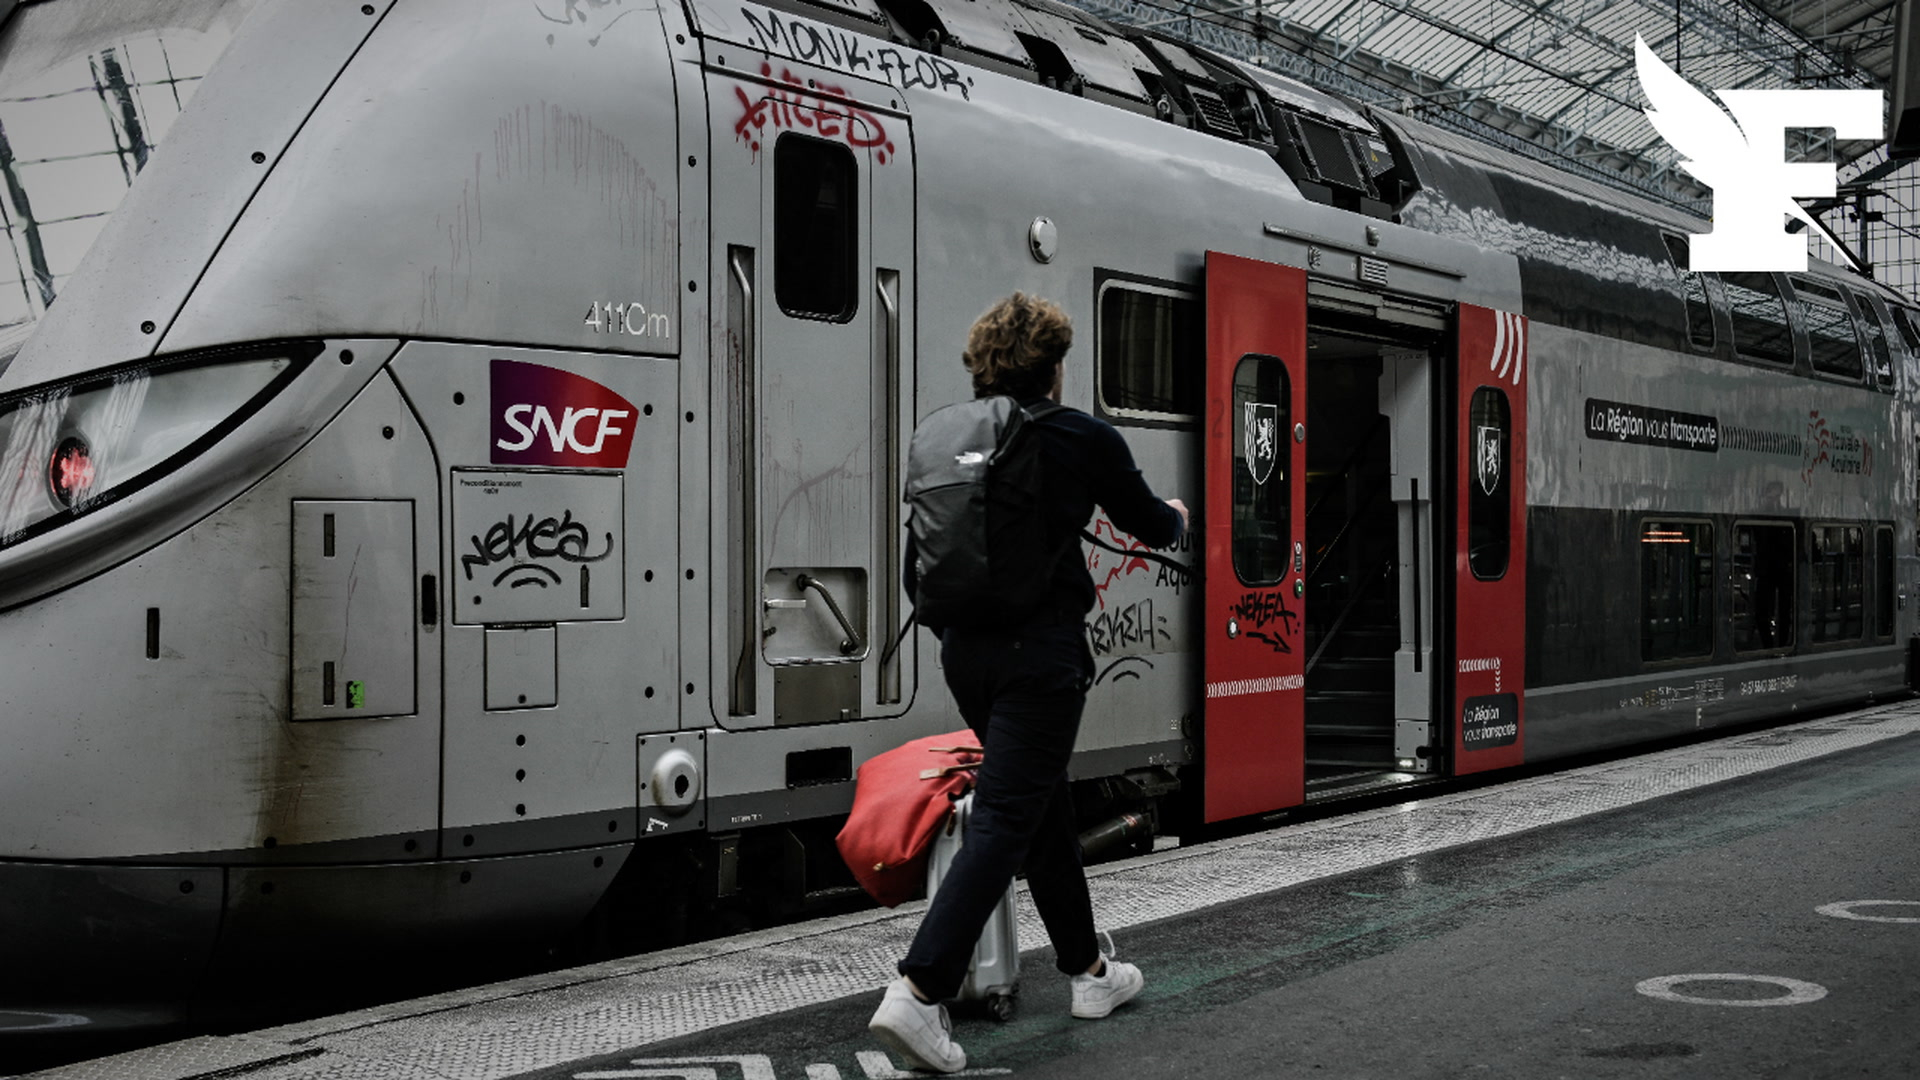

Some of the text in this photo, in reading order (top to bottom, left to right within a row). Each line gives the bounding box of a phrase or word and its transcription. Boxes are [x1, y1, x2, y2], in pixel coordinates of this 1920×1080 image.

[496, 404, 629, 454] SNCF
[1591, 405, 1717, 448] La Région vous transporte
